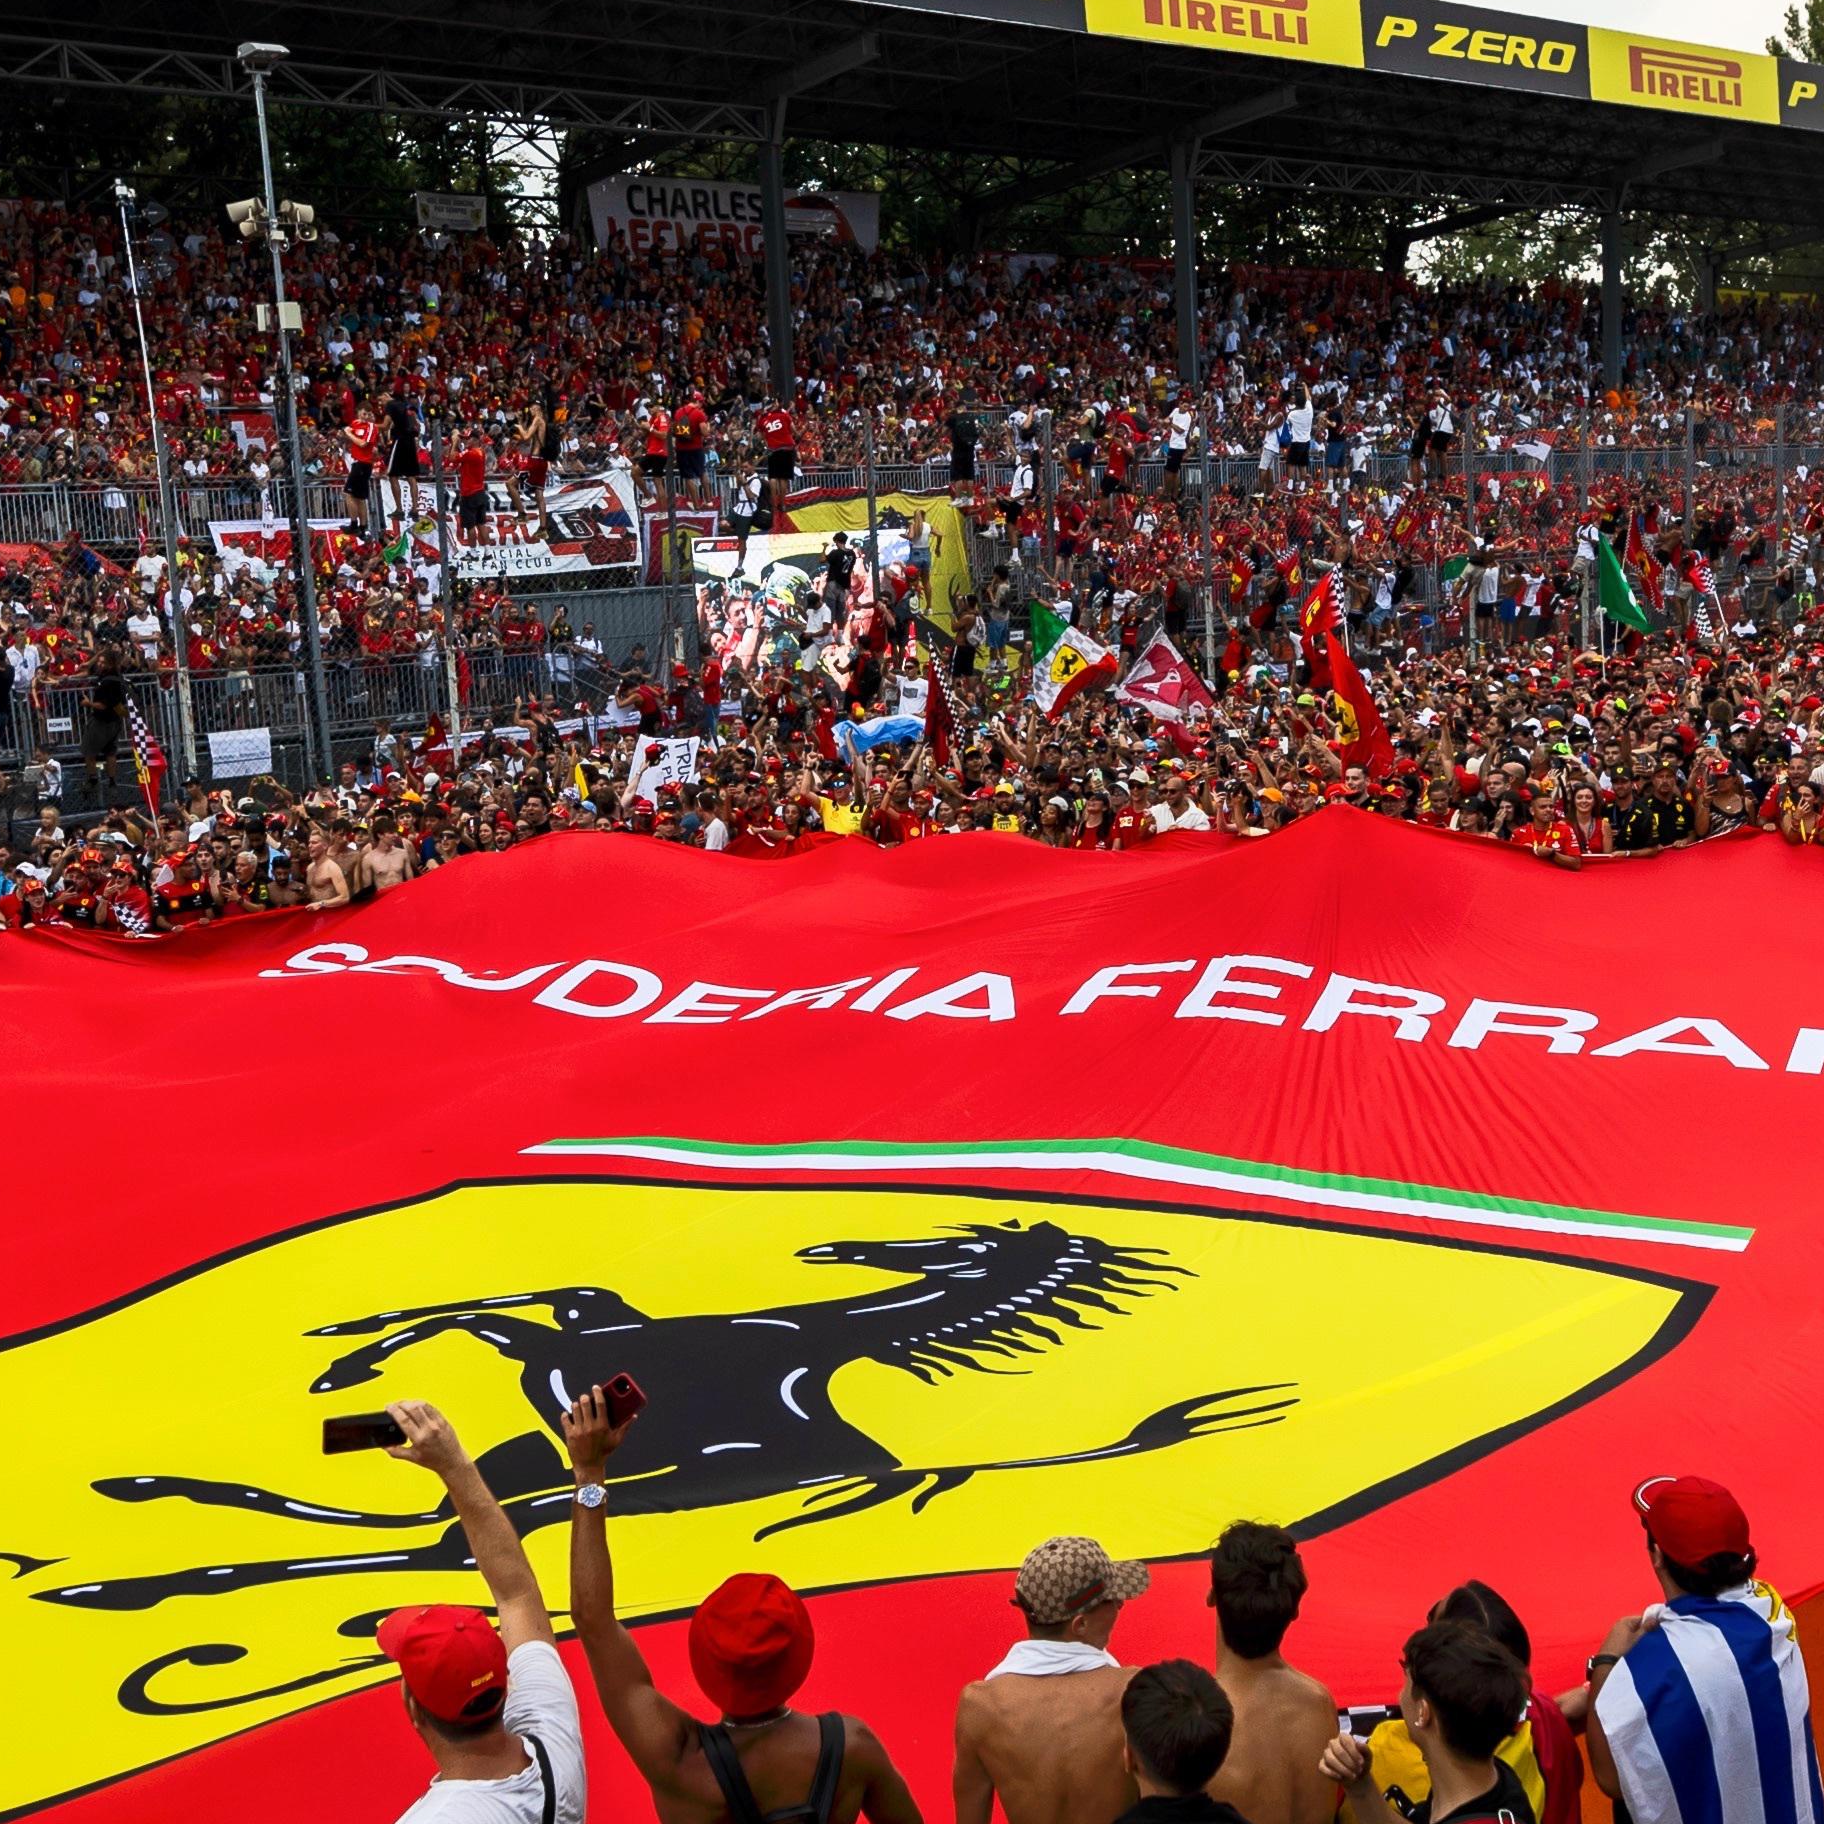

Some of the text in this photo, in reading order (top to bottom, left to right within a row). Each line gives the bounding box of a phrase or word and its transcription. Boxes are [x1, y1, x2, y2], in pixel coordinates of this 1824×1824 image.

[1377, 16, 1576, 73] P ZERO
[1629, 45, 1742, 107] PIRELLI
[1788, 80, 1817, 107] P
[627, 184, 763, 222] CHARLES
[516, 557, 552, 569] CLUB
